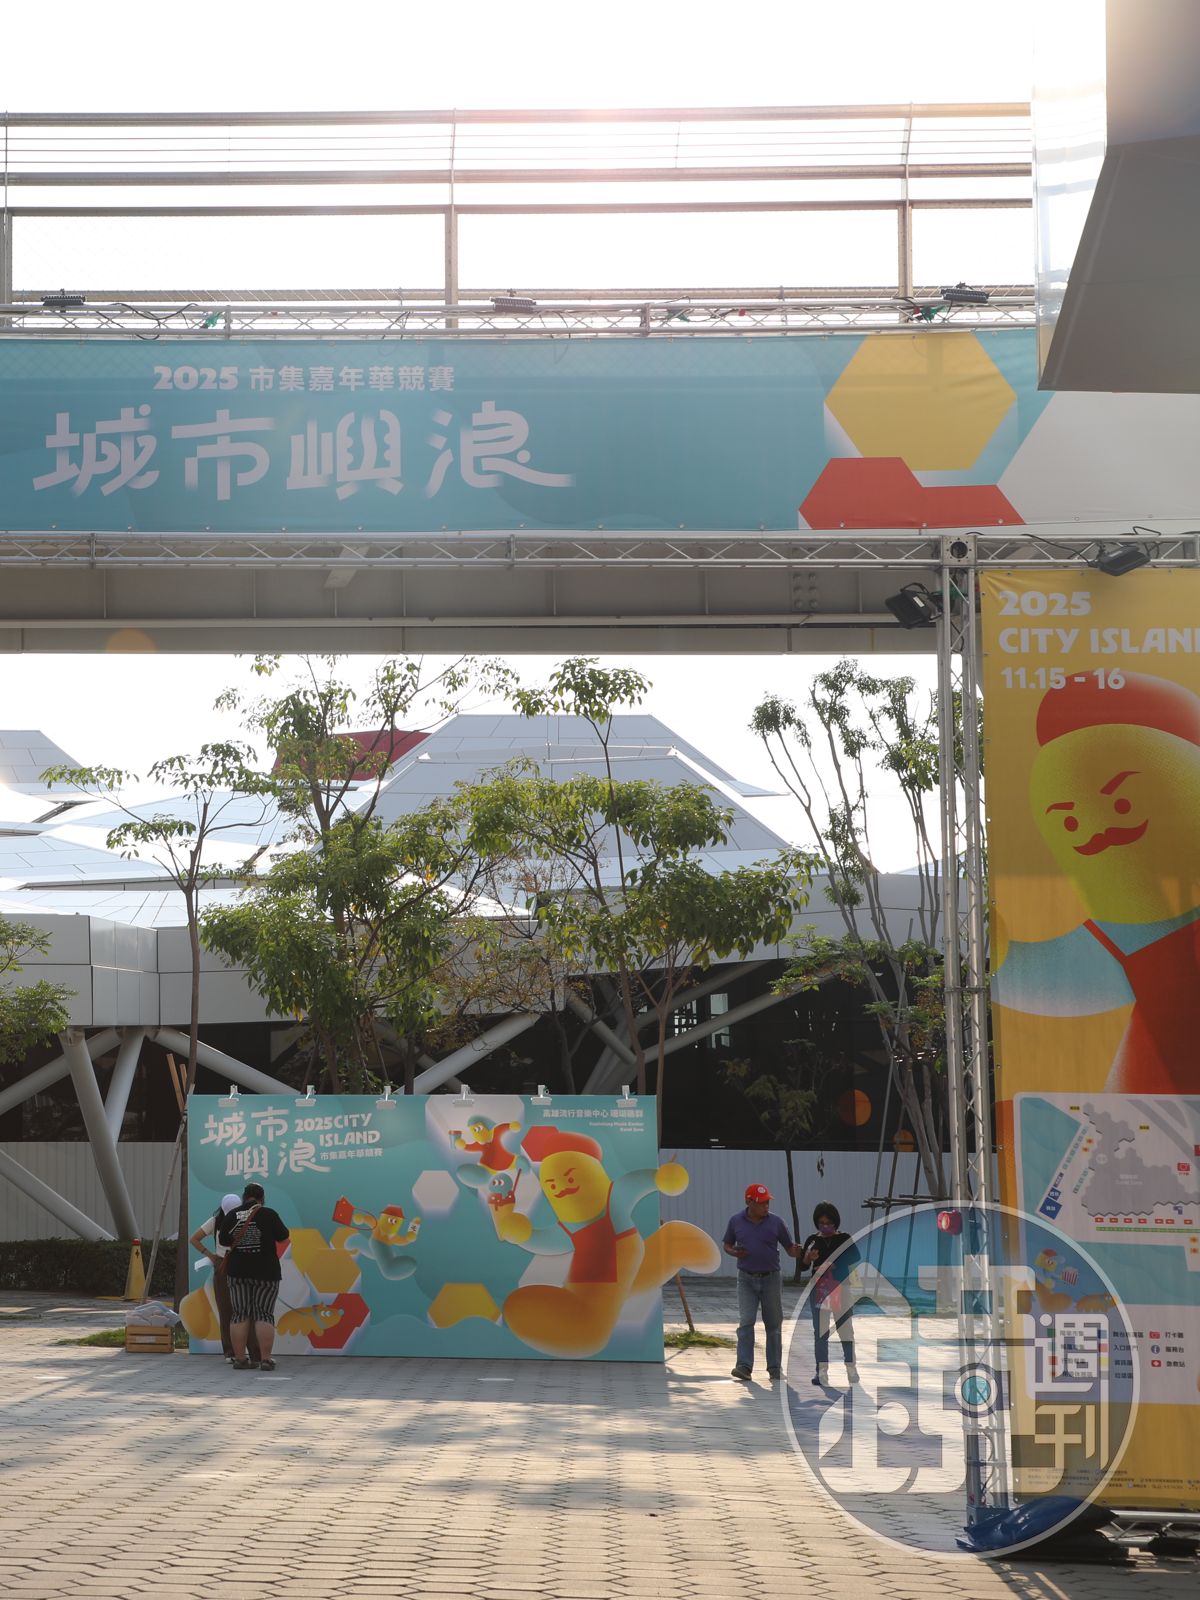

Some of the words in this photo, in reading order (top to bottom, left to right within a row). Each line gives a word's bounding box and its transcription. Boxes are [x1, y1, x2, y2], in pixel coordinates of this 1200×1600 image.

[153, 366, 239, 390] 2025
[249, 366, 455, 392] 市集嘉年華競賽
[32, 400, 576, 501] 城市嶼浪
[998, 591, 1092, 617] 2025
[998, 627, 1080, 654] CITY
[1000, 667, 1067, 690] 11.15
[1093, 667, 1126, 690] 16
[200, 1106, 289, 1147] 城市
[319, 1130, 381, 1147] ISLAND
[225, 1138, 331, 1180] 嶼浪
